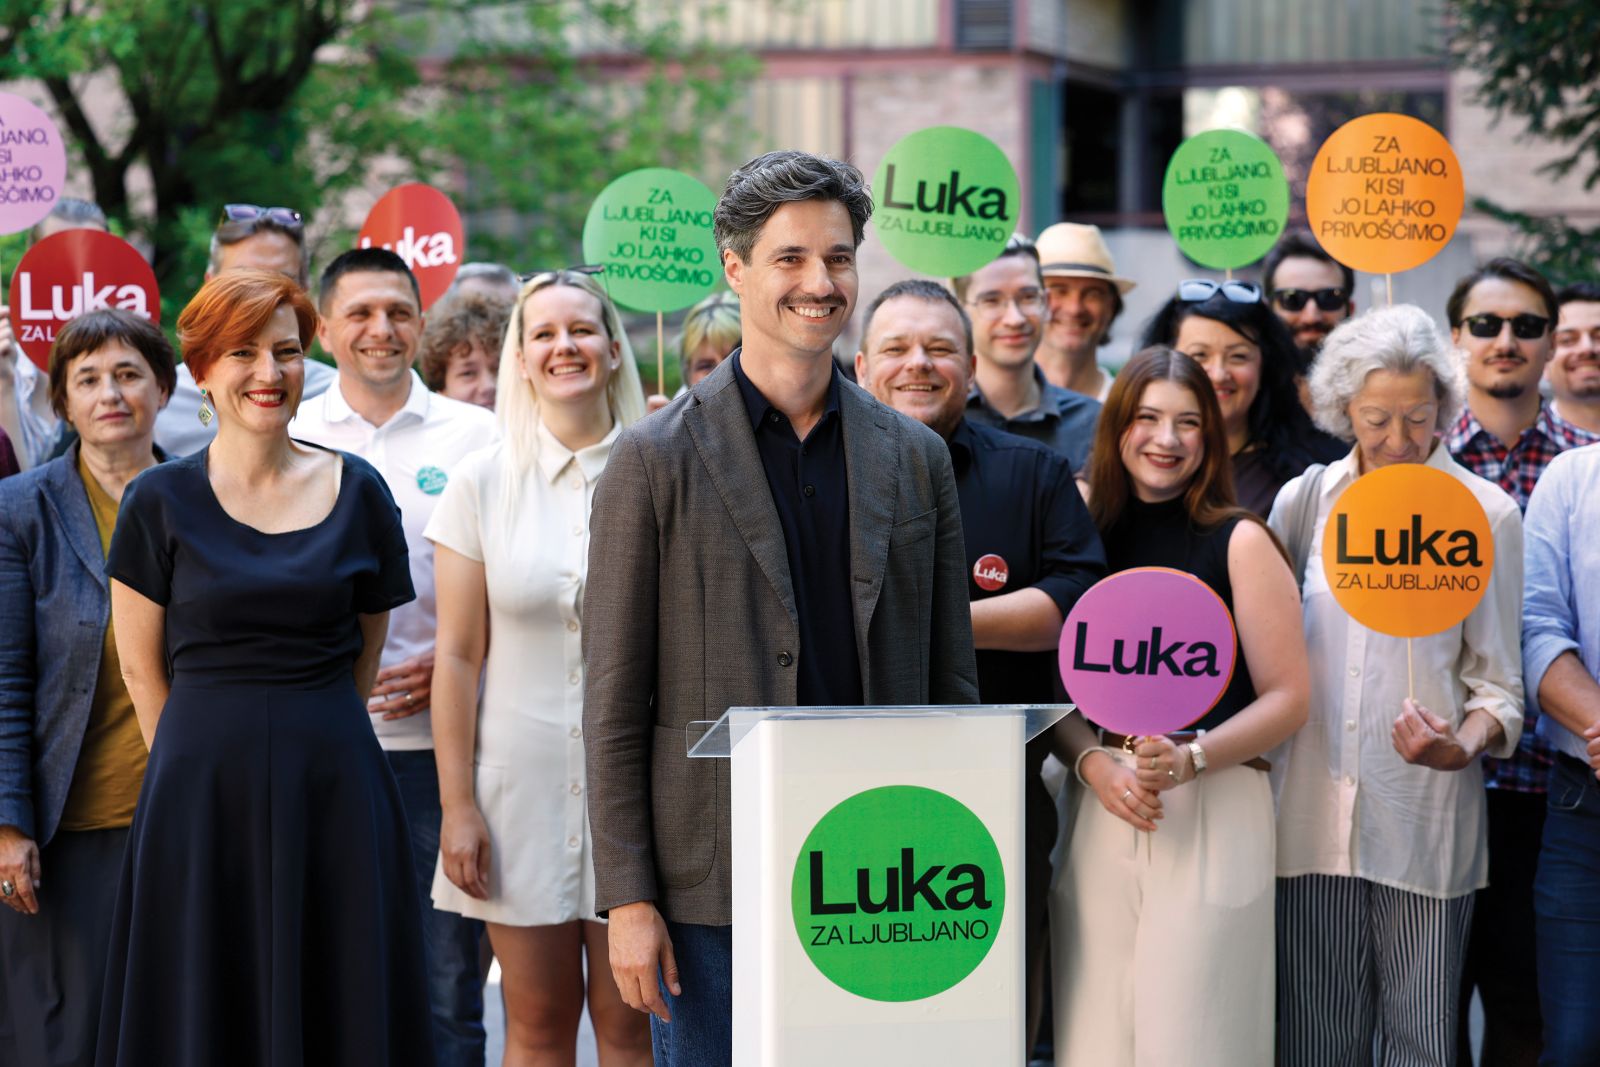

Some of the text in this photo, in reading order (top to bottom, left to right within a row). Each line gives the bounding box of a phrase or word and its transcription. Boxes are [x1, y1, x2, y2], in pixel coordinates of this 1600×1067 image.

[1209, 147, 1232, 163] ZA
[1373, 136, 1400, 153] ZA
[1326, 156, 1448, 179] LJUBLJANO,
[648, 188, 673, 204] ZA
[882, 163, 1009, 222] Luka
[1208, 183, 1239, 200] KI SI
[1365, 178, 1404, 195] KI SI
[1186, 199, 1267, 221] JO LAHKO
[1333, 198, 1436, 218] JO LAHKO
[640, 225, 677, 242] KI SI
[880, 215, 1005, 243] ZA LJUBLJANO
[1179, 219, 1279, 241] PRIVOŠČIMO
[1321, 218, 1446, 242] PRIVOŠČIMO
[609, 242, 704, 264] JO LAHKO
[19, 271, 152, 321] Luka
[21, 325, 45, 342] ZA
[1336, 513, 1483, 568] Luka
[974, 562, 1007, 584] Luka
[1336, 573, 1481, 592] ZA LJUBLJANO
[1073, 621, 1220, 677] Luka
[809, 847, 993, 916] Luka
[810, 919, 989, 946] ZA LJUBLJANO
